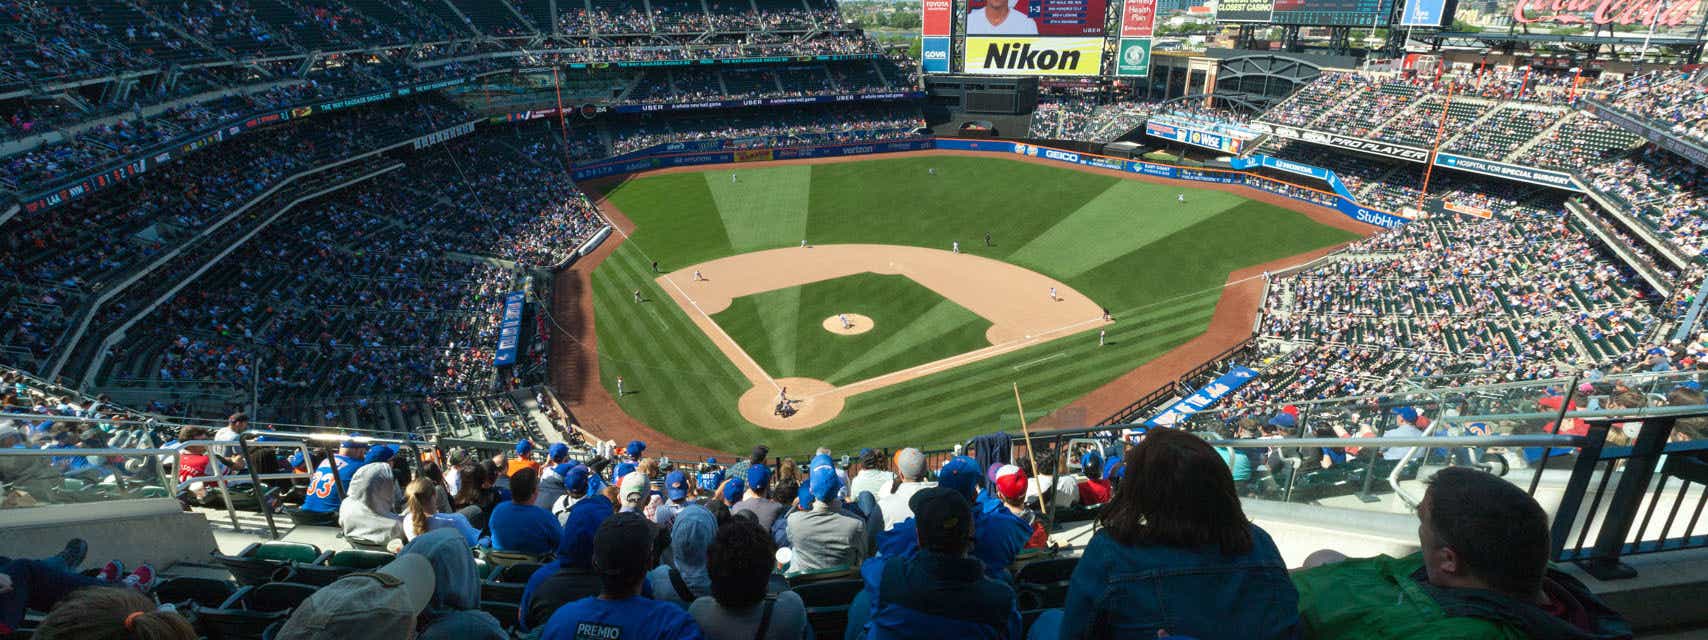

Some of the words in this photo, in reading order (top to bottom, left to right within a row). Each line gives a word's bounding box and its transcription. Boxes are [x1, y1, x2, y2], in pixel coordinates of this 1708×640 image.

[1128, 5, 1151, 14] Health
[1218, 3, 1246, 11] CLOSEST
[1246, 3, 1272, 11] CASINO
[1131, 13, 1146, 21] Plan
[983, 42, 1081, 70] Nikon
[1201, 132, 1221, 147] WISE
[843, 146, 873, 155] verizon
[1329, 137, 1361, 148] PRO
[1363, 142, 1426, 160] PLAYER
[1045, 150, 1078, 162] GEICO
[586, 166, 613, 177] DELTA
[1283, 161, 1313, 174] HONDA
[1456, 159, 1485, 170] HOSPITAL
[1487, 164, 1501, 173] FOR
[1501, 167, 1532, 179] SPECIAL
[1533, 173, 1570, 185] SURGERY
[577, 623, 620, 639] PREMIO
